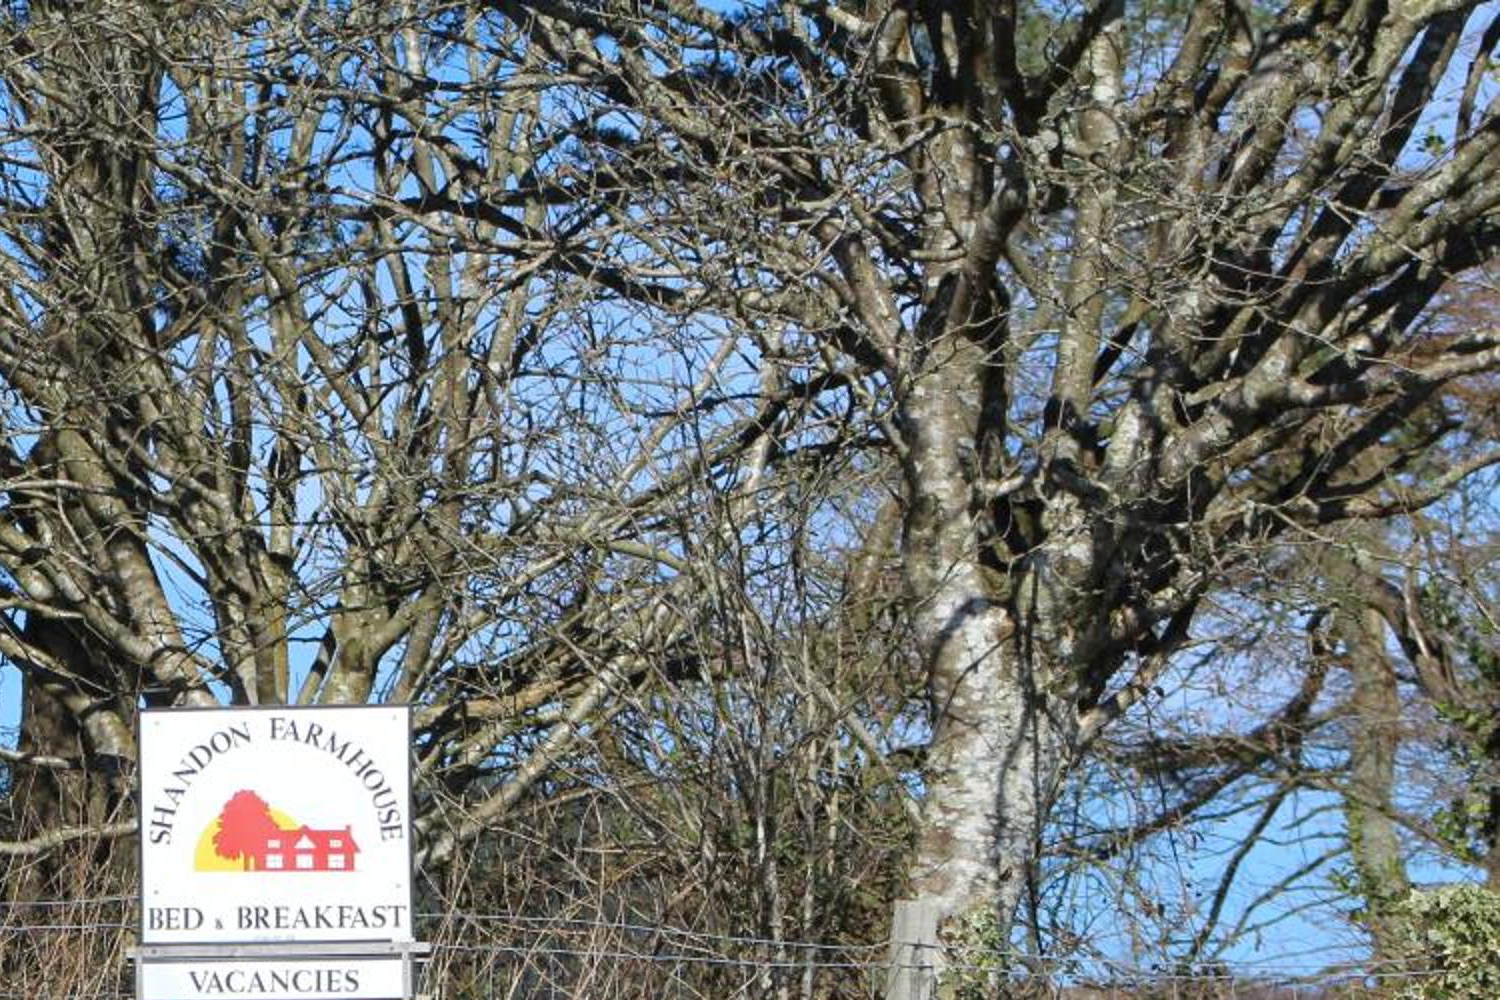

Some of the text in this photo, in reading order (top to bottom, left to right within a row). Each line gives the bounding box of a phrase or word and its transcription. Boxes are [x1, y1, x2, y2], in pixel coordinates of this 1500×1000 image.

[149, 717, 404, 846] SHANDON FARMHOUSE
[148, 905, 407, 931] BED & BREAKFAST
[188, 969, 360, 994] VACANCIES
